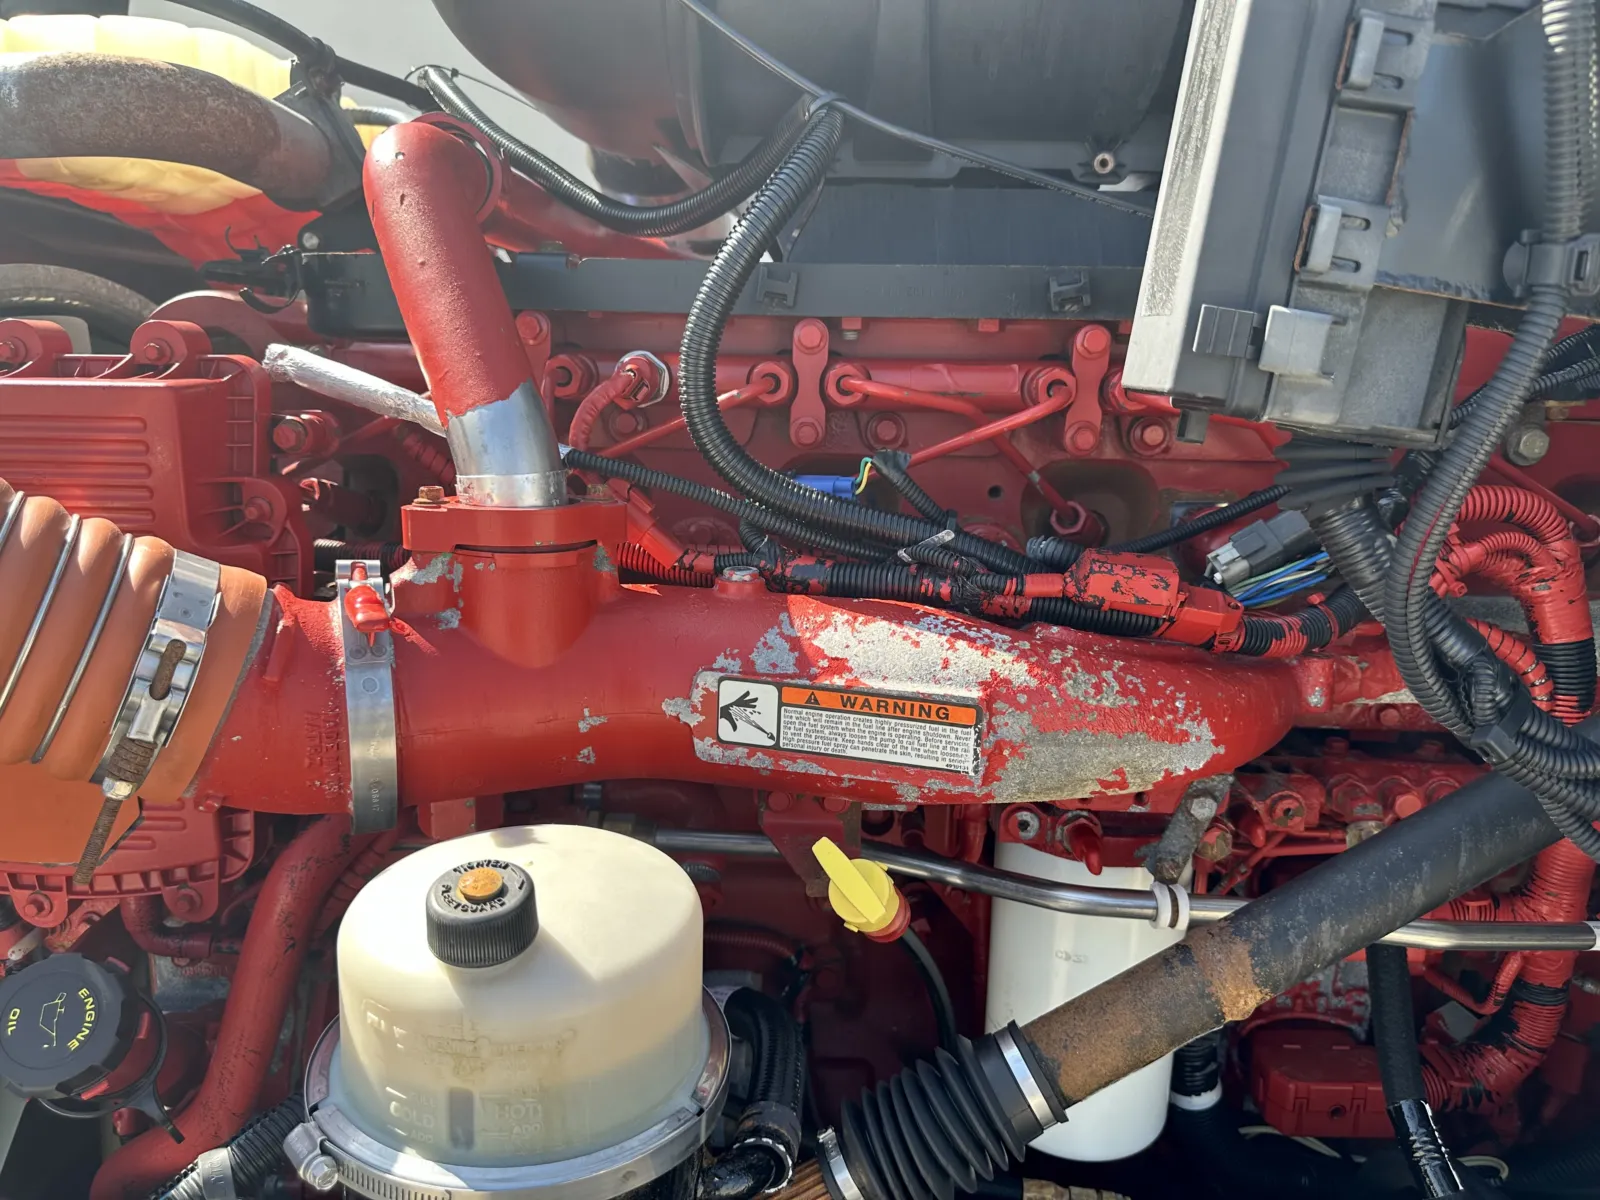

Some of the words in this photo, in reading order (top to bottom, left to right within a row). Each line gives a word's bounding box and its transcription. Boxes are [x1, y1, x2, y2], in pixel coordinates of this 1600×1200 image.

[840, 694, 950, 721] WARNING
[805, 711, 822, 719] engine
[825, 714, 850, 722] operation
[875, 719, 891, 727] highly
[895, 722, 926, 731] pressurized
[805, 728, 826, 736] system,
[828, 731, 846, 739] always
[820, 724, 839, 732] system
[868, 730, 885, 738] engine
[895, 733, 922, 743] operating.
[902, 728, 920, 736] engine
[923, 731, 952, 739] shutdown.
[782, 742, 804, 750] personal
[861, 746, 887, 755] penetrate
[900, 751, 912, 759] skin,
[914, 753, 939, 762] resulting
[453, 859, 510, 874] TIGHTEN
[7, 1008, 21, 1036] OIL
[67, 987, 96, 1051] ENGINE
[389, 1100, 435, 1128] COLD
[495, 1103, 538, 1120] HOT
[410, 1129, 434, 1144] ADD
